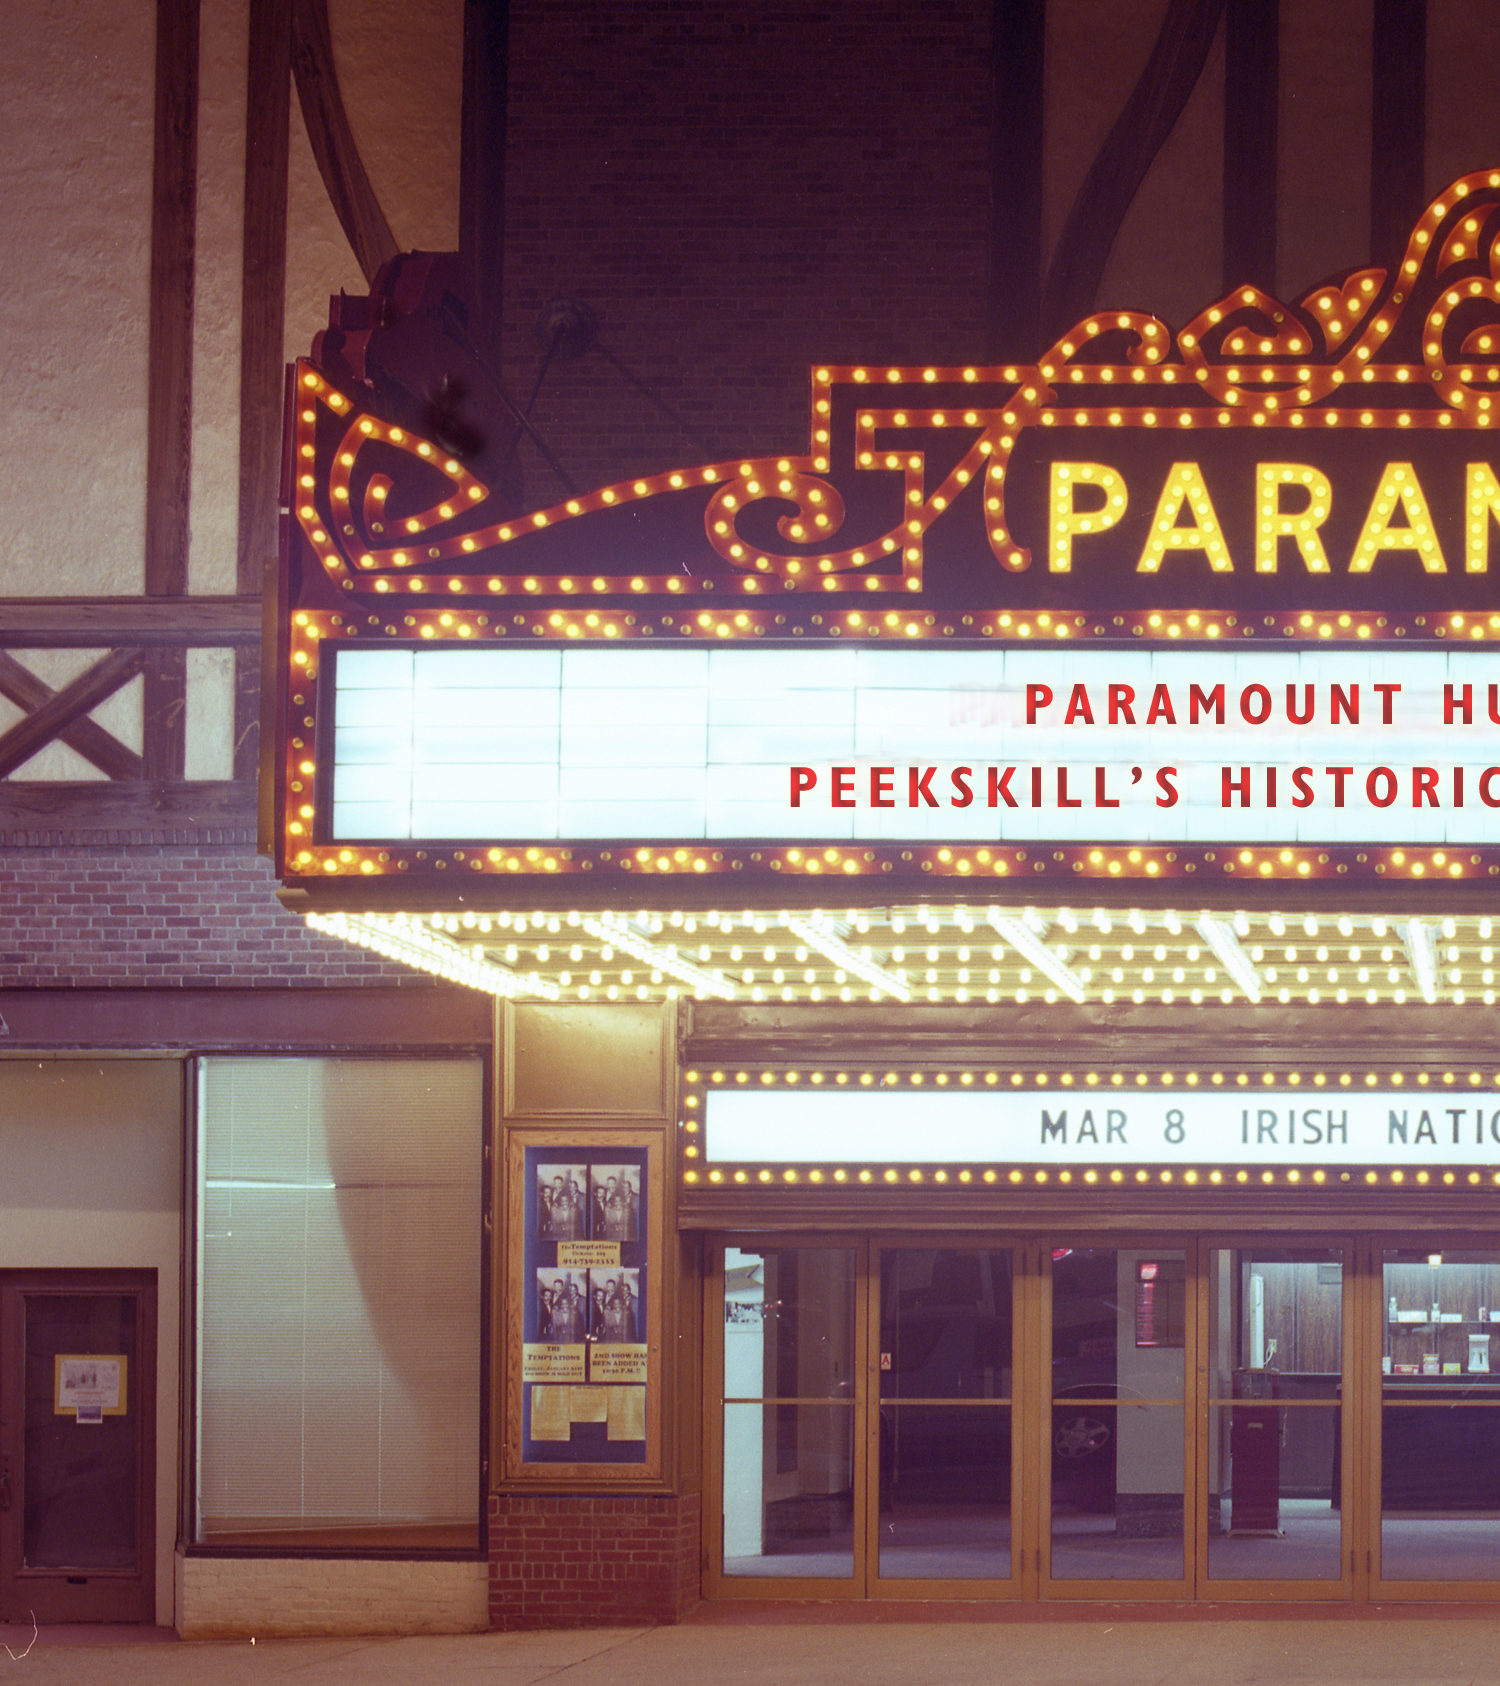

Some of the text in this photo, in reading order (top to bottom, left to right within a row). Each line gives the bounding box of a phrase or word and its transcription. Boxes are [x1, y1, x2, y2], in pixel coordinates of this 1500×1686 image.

[1026, 683, 1402, 725] PARAMOUNT
[790, 766, 1179, 808] PEEKSKILL'S
[1041, 1110, 1128, 1145] MAR
[1165, 1110, 1186, 1145] 8
[1243, 1110, 1348, 1146] IRISH
[571, 1243, 617, 1251] Temptations
